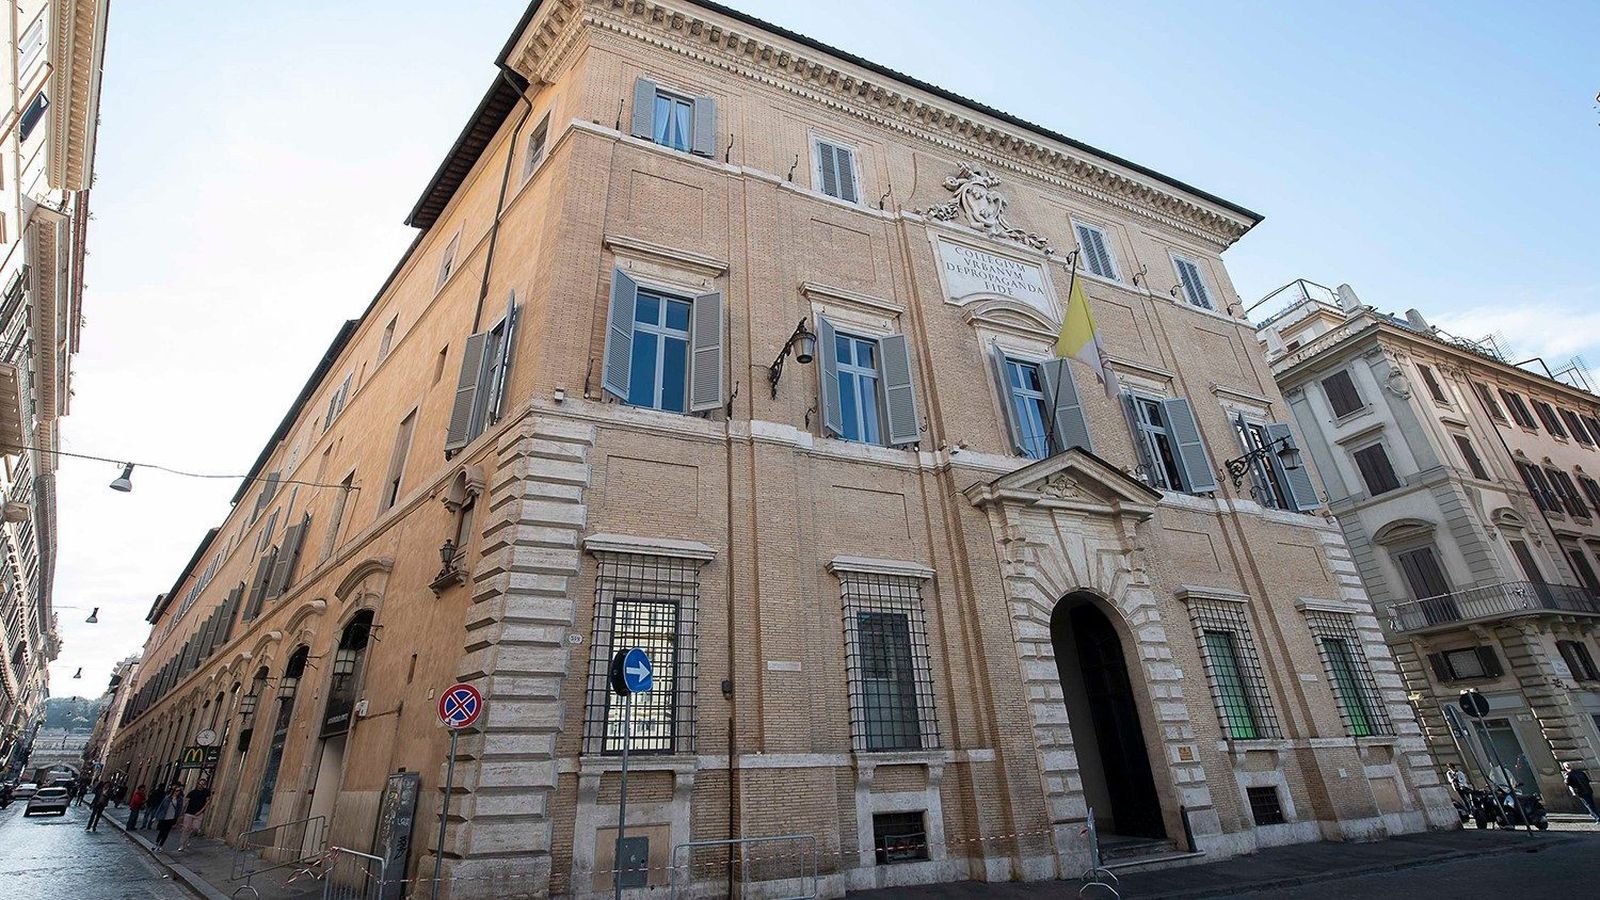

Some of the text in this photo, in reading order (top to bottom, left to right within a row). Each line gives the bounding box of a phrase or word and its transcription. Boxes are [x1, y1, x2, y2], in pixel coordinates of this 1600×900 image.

[955, 247, 1025, 272] COLLEGIVM
[964, 257, 1024, 281] VRBANVM
[984, 281, 1015, 295] FIDE
